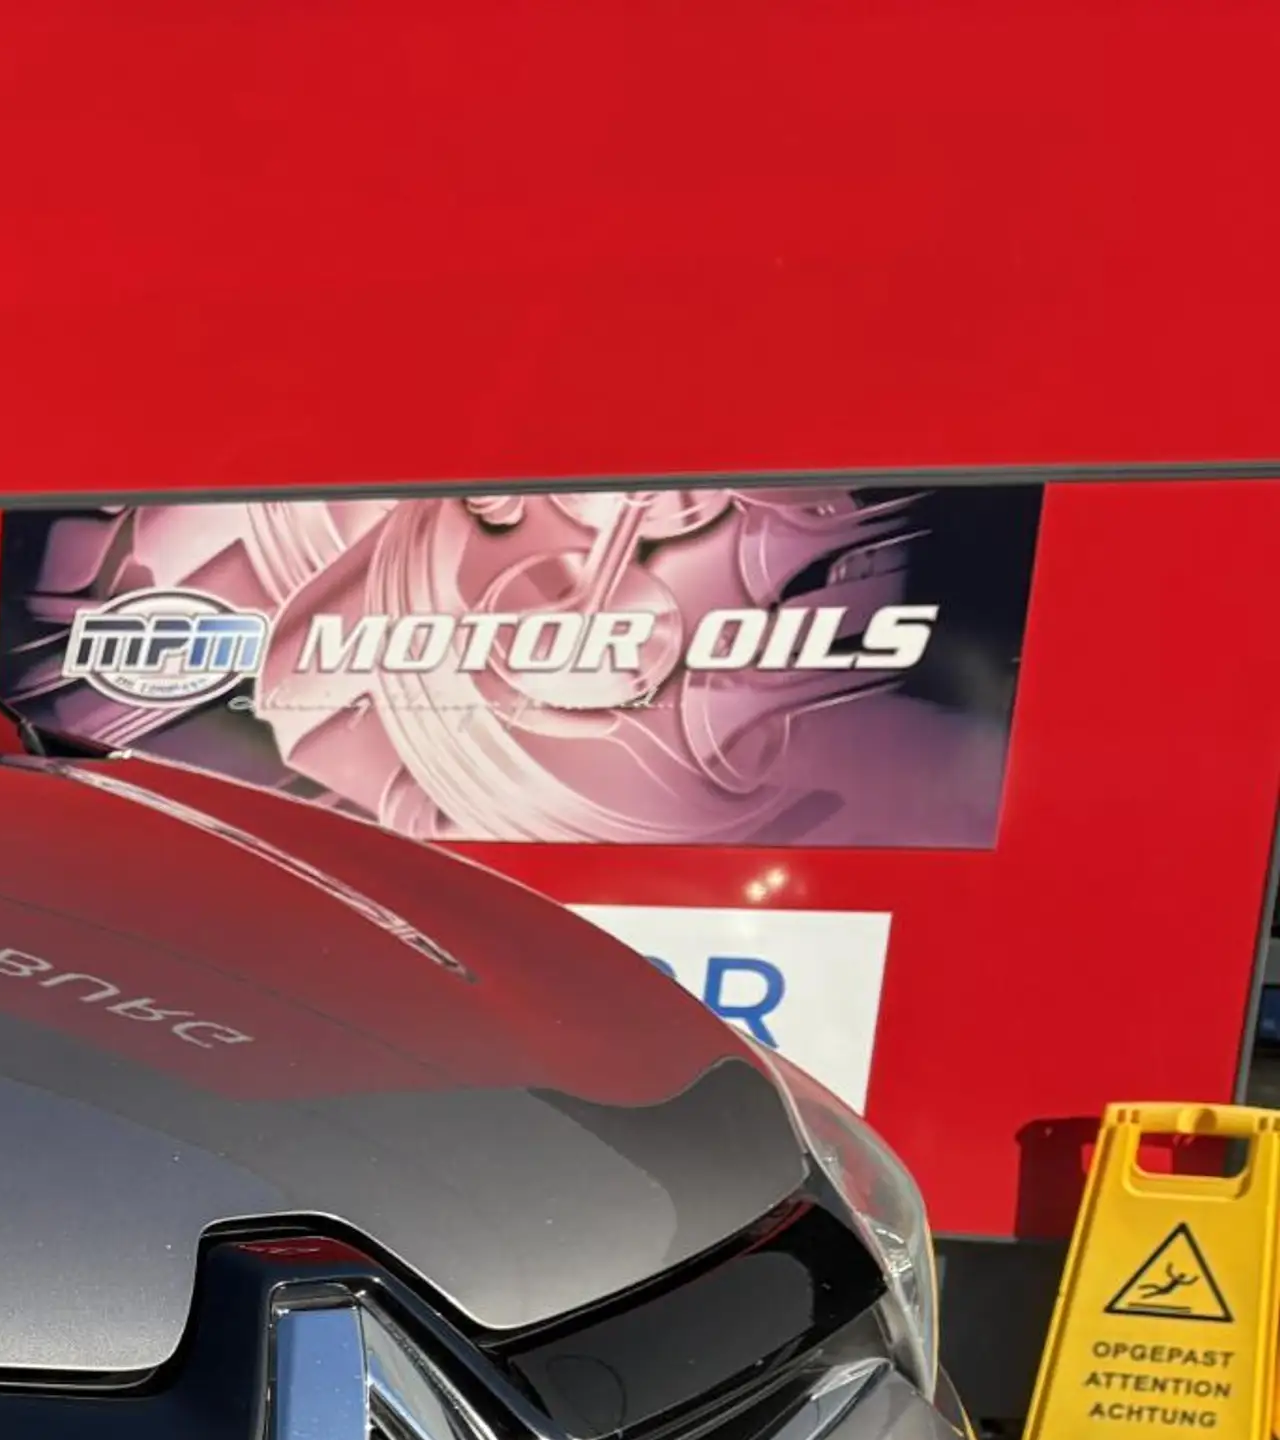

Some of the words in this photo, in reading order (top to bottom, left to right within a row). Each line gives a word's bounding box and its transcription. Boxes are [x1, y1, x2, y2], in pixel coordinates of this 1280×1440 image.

[296, 608, 658, 675] MOTOR
[686, 603, 941, 671] OILS
[1092, 1340, 1236, 1368] OPGEPAST
[1083, 1372, 1233, 1399] ATTENTION
[1088, 1402, 1219, 1429] ACHTUNG
